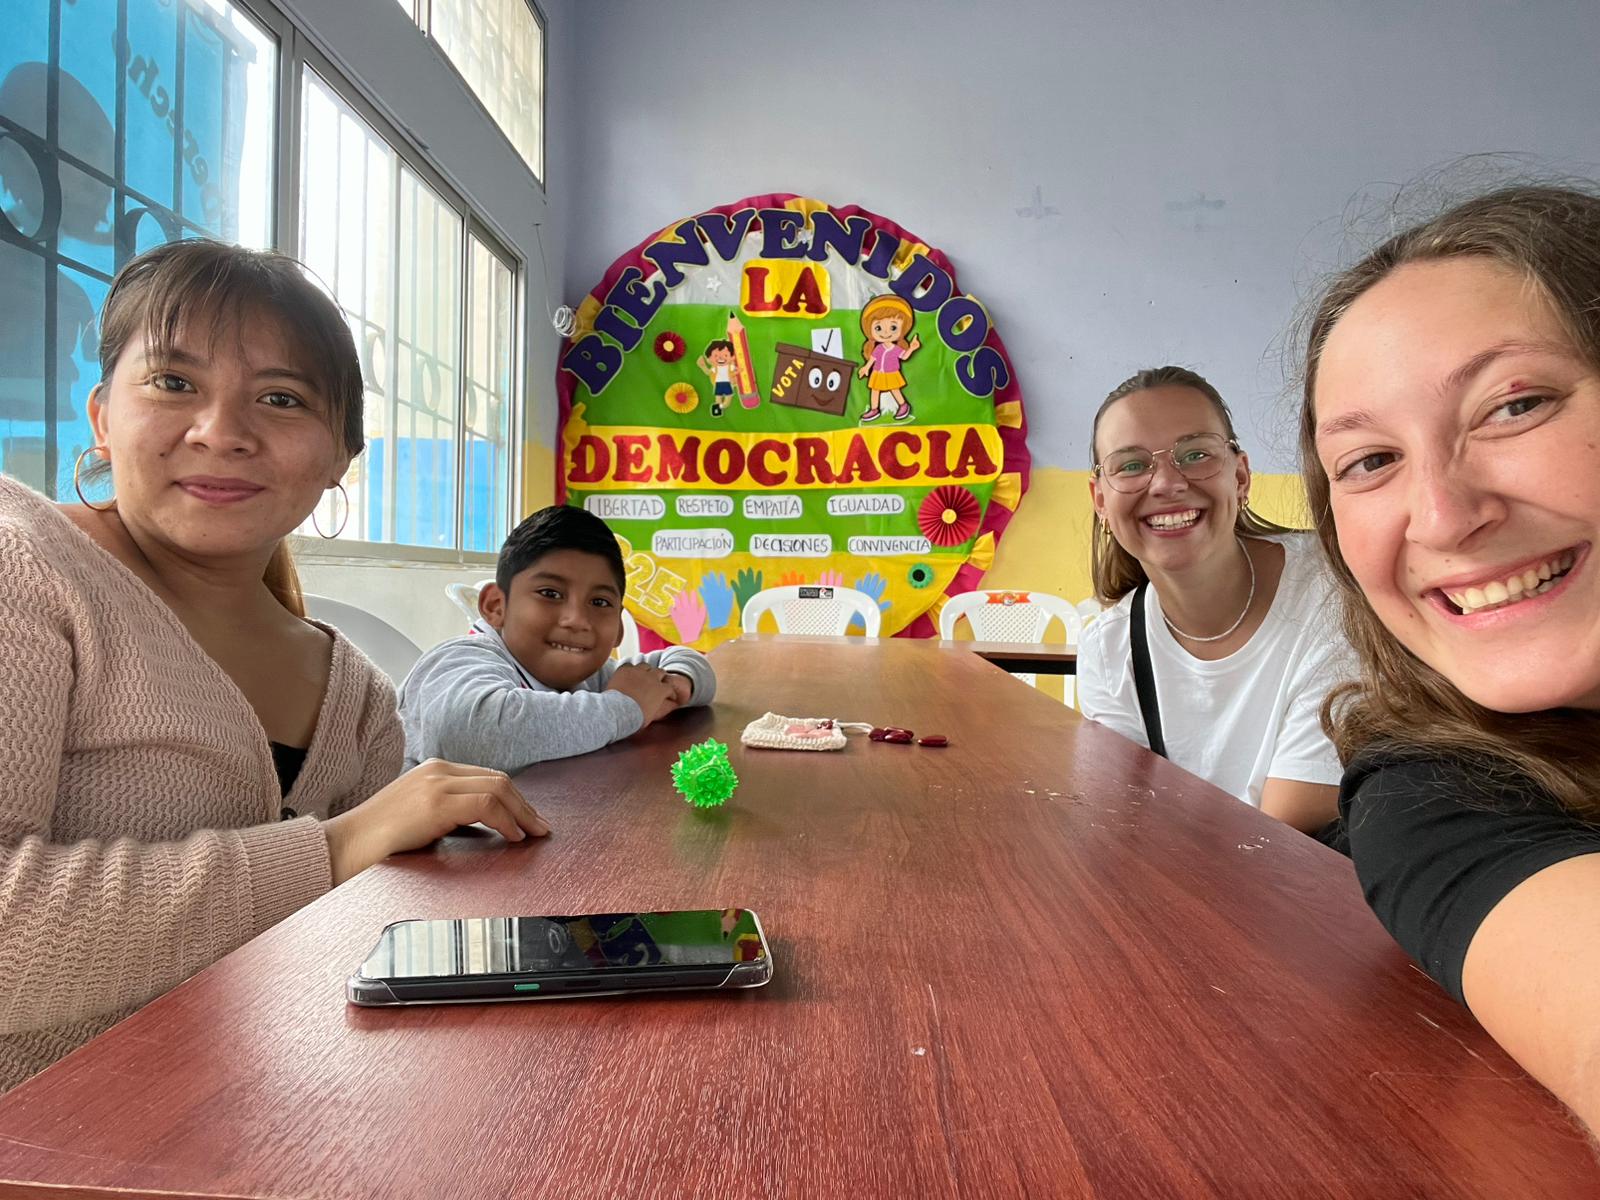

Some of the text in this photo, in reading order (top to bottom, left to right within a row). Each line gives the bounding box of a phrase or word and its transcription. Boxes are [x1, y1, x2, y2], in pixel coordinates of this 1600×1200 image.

[562, 208, 1010, 396] BIENVENIDOS
[744, 266, 828, 314] LA
[772, 359, 804, 398] VOTA
[567, 427, 998, 486] DEMOCRACIA
[587, 497, 664, 517] LIBERTAD
[678, 498, 729, 514] RESPETO
[830, 498, 902, 513] IGUALDAD
[753, 536, 829, 553] DECISIONES
[849, 538, 931, 553] CONVIVENCIA
[614, 533, 688, 617] 25
